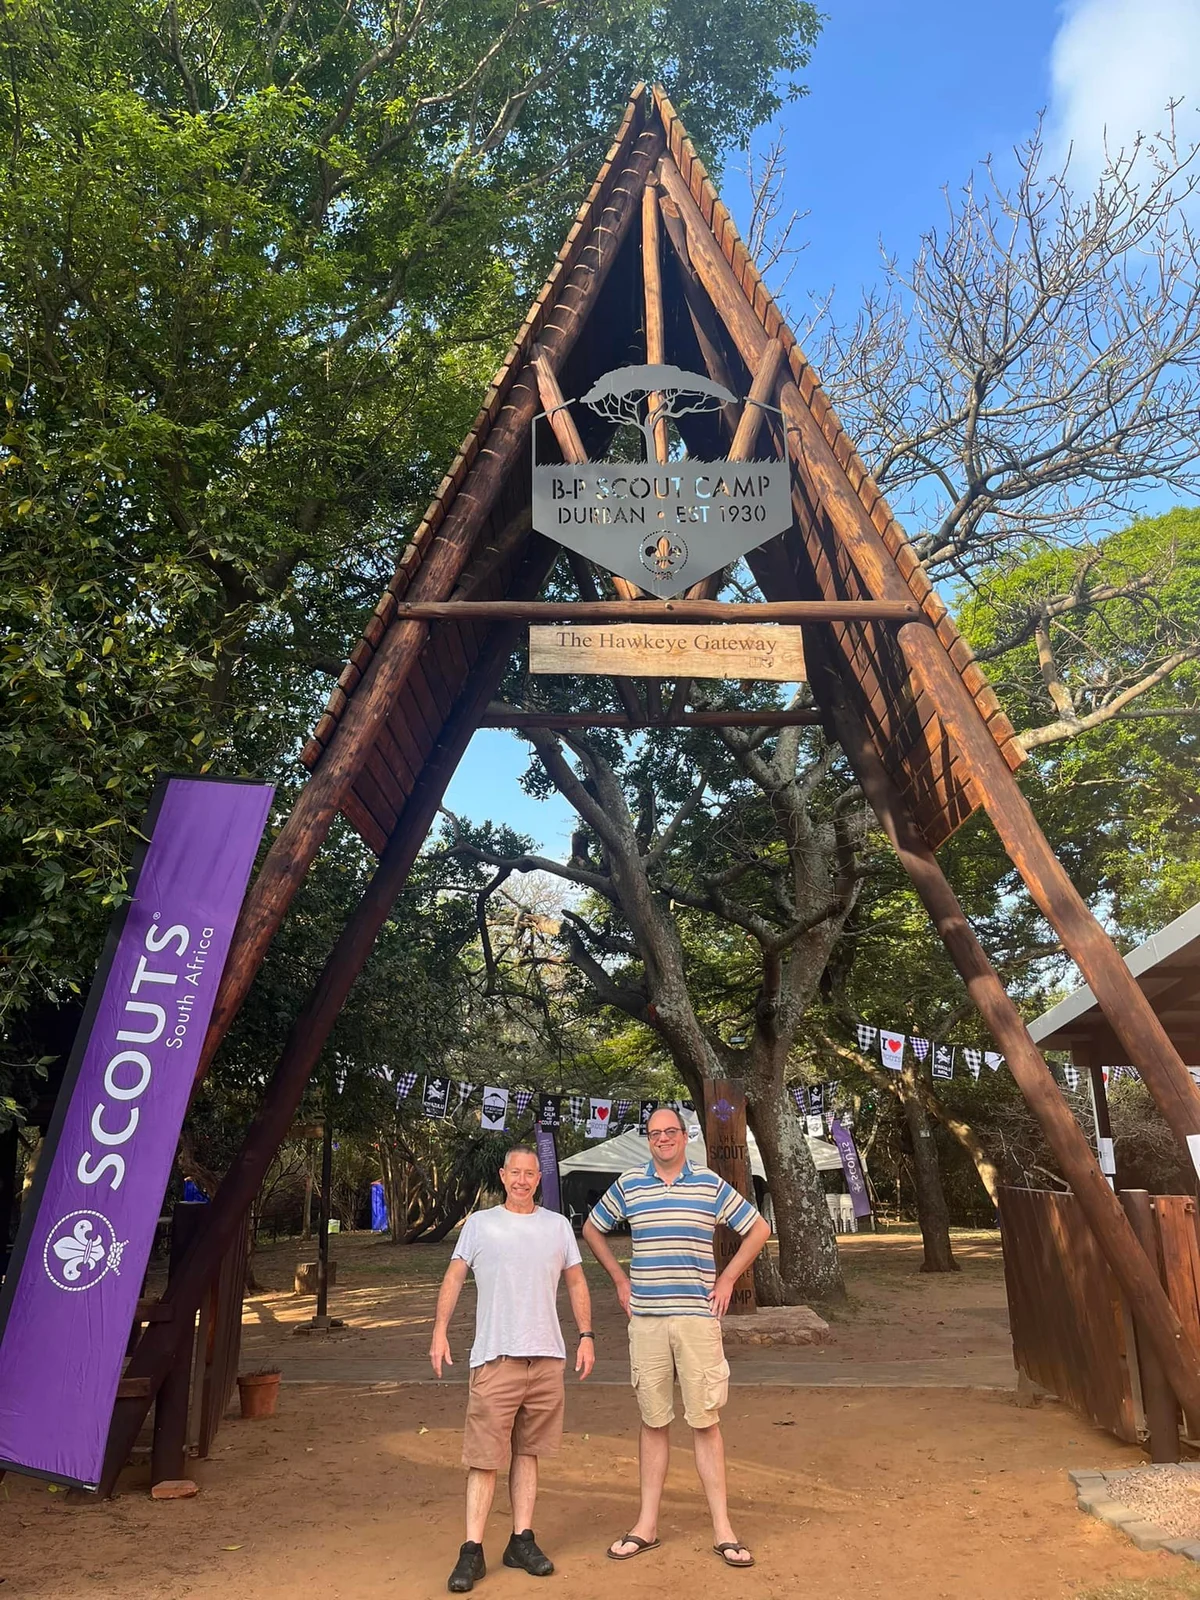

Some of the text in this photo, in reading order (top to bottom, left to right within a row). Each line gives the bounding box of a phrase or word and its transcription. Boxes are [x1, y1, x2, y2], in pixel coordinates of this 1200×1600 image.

[551, 475, 770, 500] B-P SCOUT CAMP
[558, 504, 767, 524] DURBAN EST 1930
[556, 632, 778, 655] The Hawkeye Gateway
[166, 927, 215, 1049] South Africa
[709, 1144, 745, 1160] SCOUT
